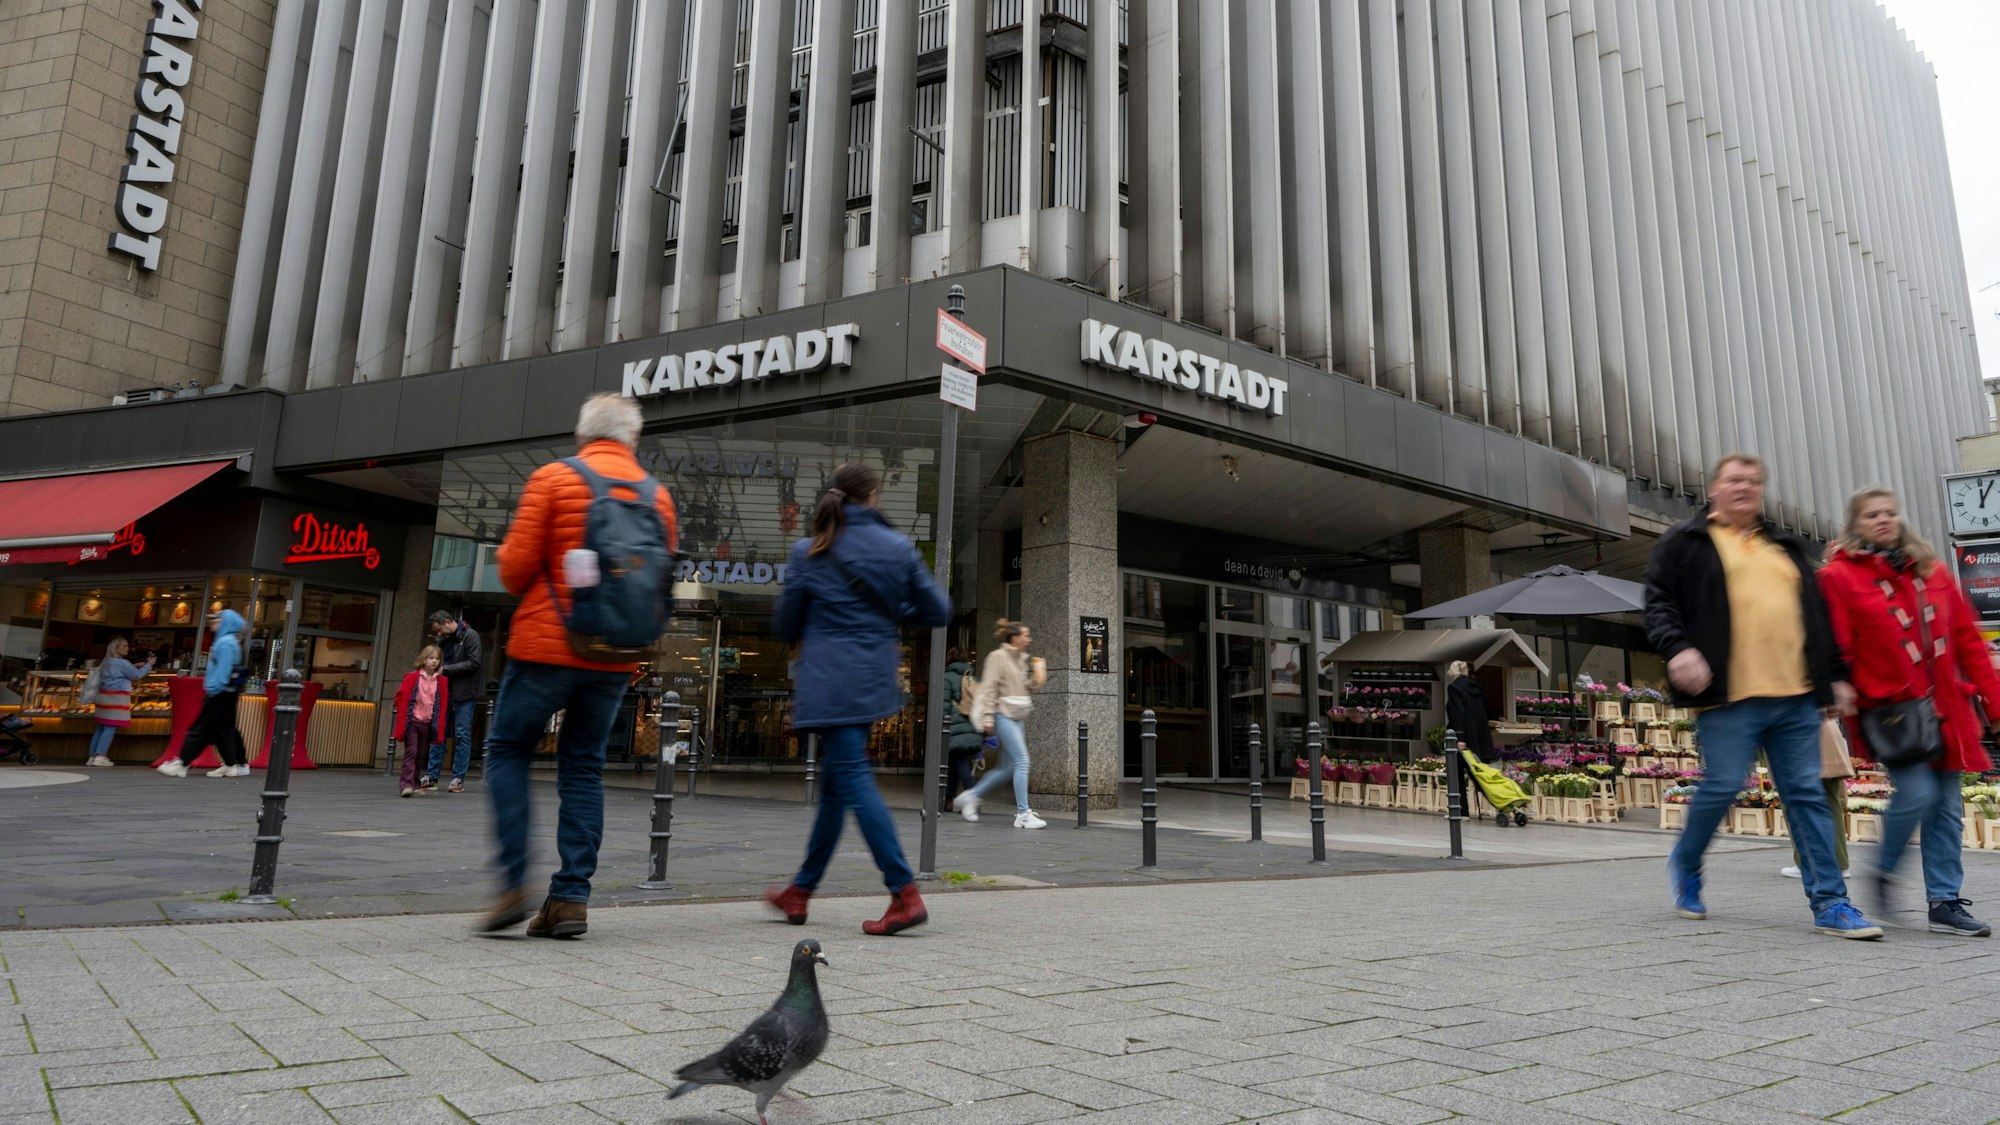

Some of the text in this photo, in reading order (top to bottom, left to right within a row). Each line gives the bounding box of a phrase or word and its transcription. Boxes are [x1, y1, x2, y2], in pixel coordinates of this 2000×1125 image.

[107, 0, 202, 271] ARSTADT
[622, 323, 859, 398] KARSTADT
[1080, 318, 1288, 416] KARSTADT
[286, 512, 373, 559] Ditsch
[675, 560, 789, 584] RSTADT
[1224, 558, 1283, 580] dean & david
